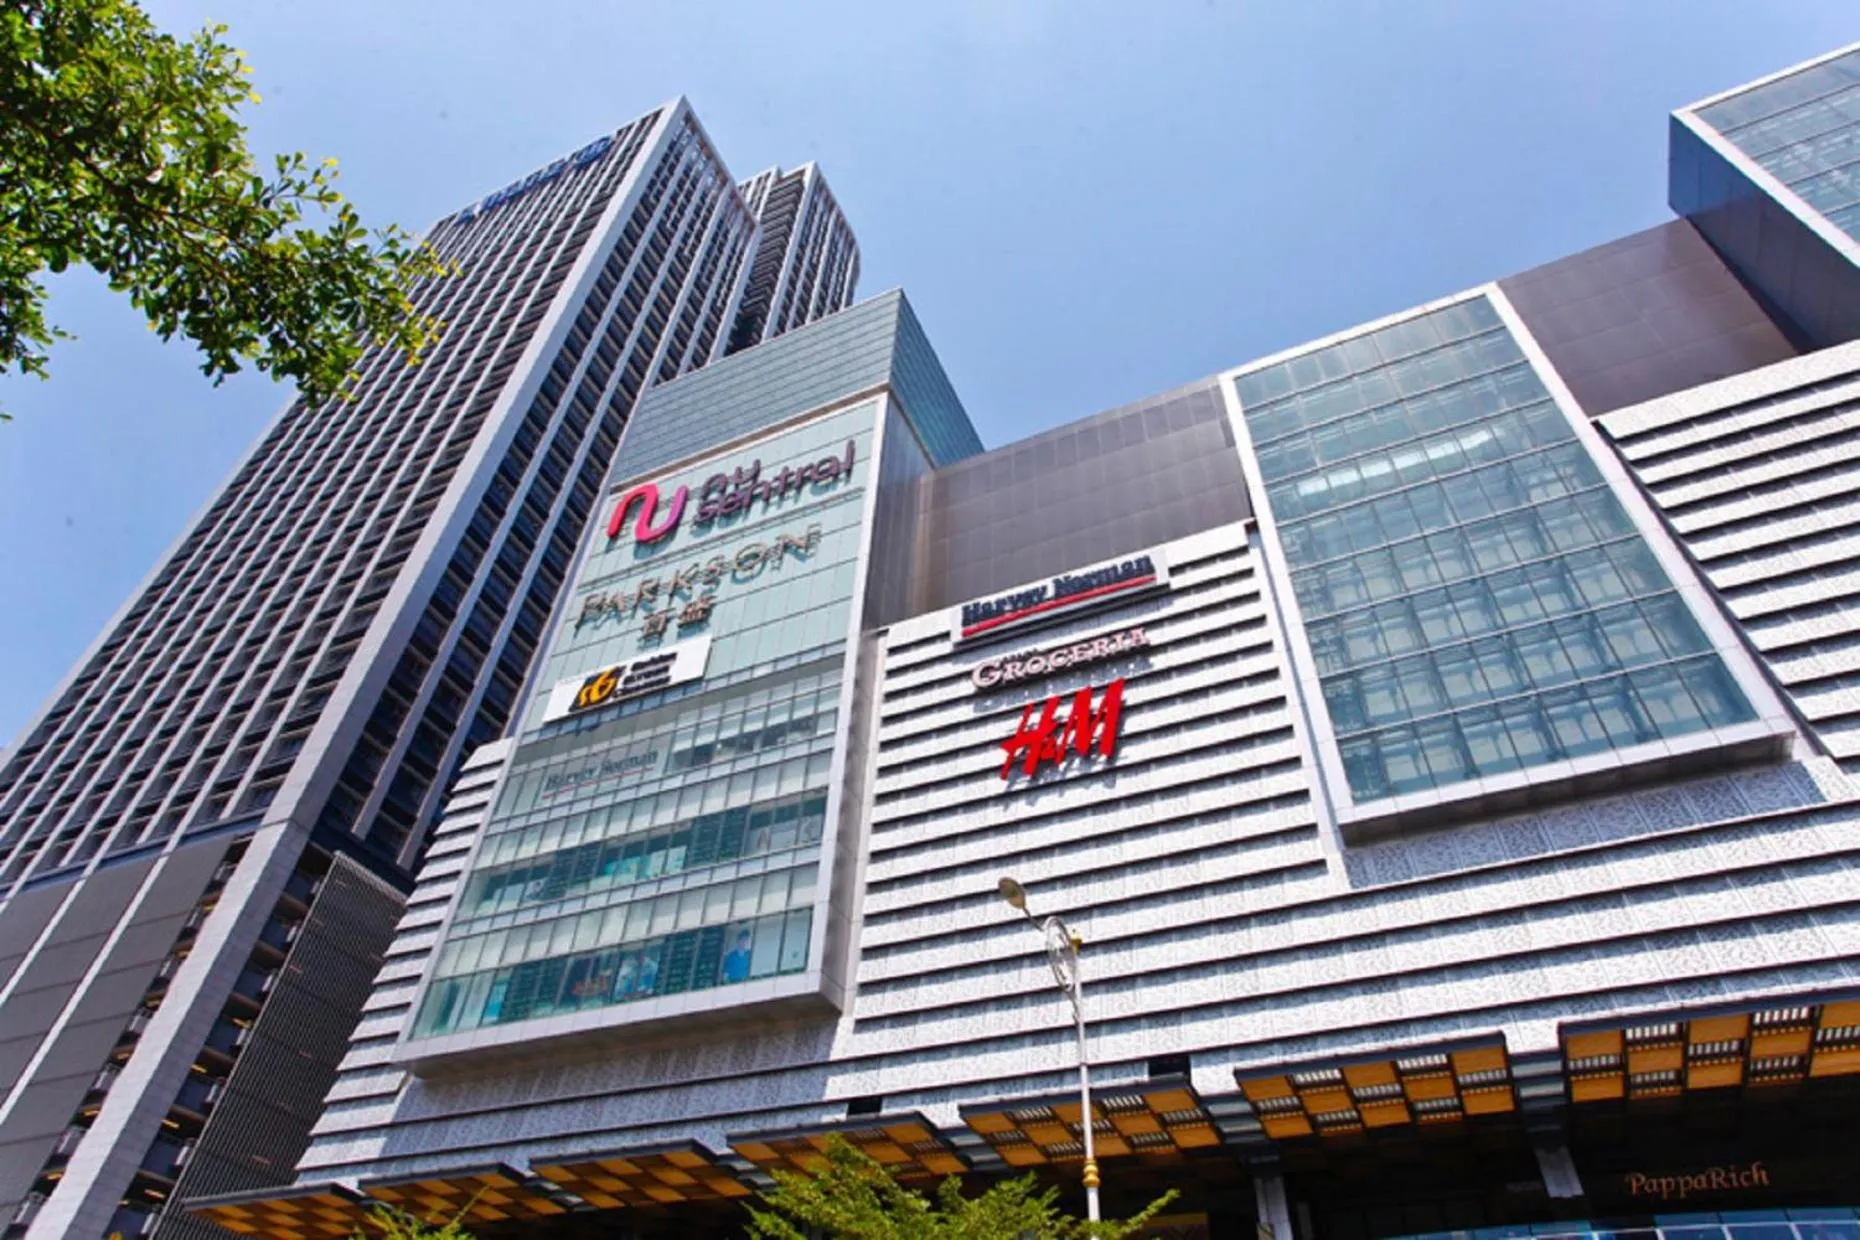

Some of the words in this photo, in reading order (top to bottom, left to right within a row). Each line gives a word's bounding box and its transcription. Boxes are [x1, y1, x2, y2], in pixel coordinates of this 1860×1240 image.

[574, 523, 822, 630] PARKSON
[962, 585, 1048, 627] Harvey
[1053, 555, 1156, 597] Norman
[972, 628, 1151, 688] GROCERIA
[999, 676, 1127, 781] H&M
[1626, 1162, 1771, 1199] PappaRich
